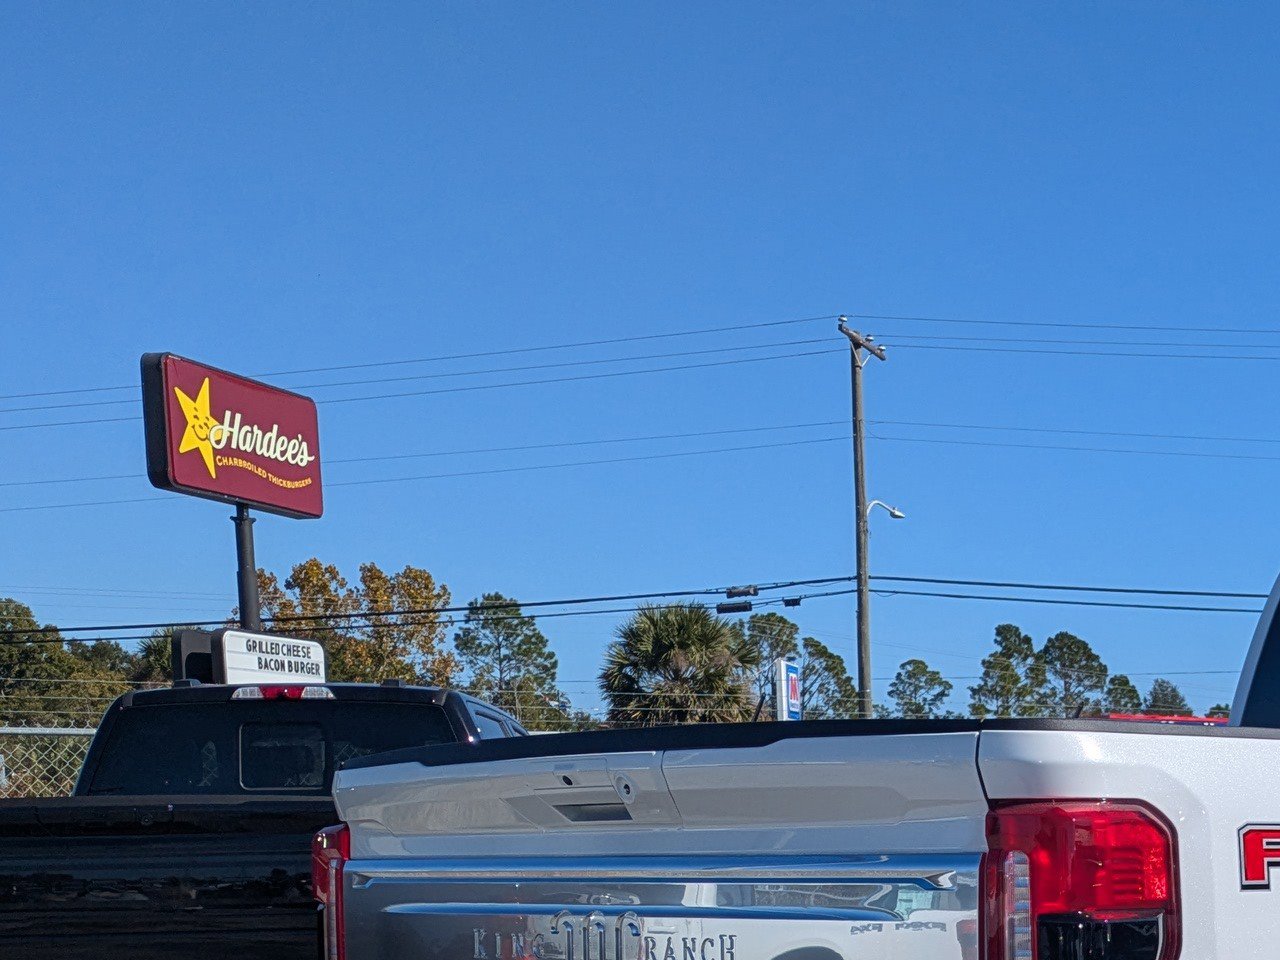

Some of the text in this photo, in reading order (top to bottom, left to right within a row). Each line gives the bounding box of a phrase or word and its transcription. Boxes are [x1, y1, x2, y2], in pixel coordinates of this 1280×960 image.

[209, 410, 315, 466] Hardee's
[216, 455, 267, 479] CHARBROILED
[257, 657, 321, 676] BACON BURGER
[472, 927, 545, 960] KING
